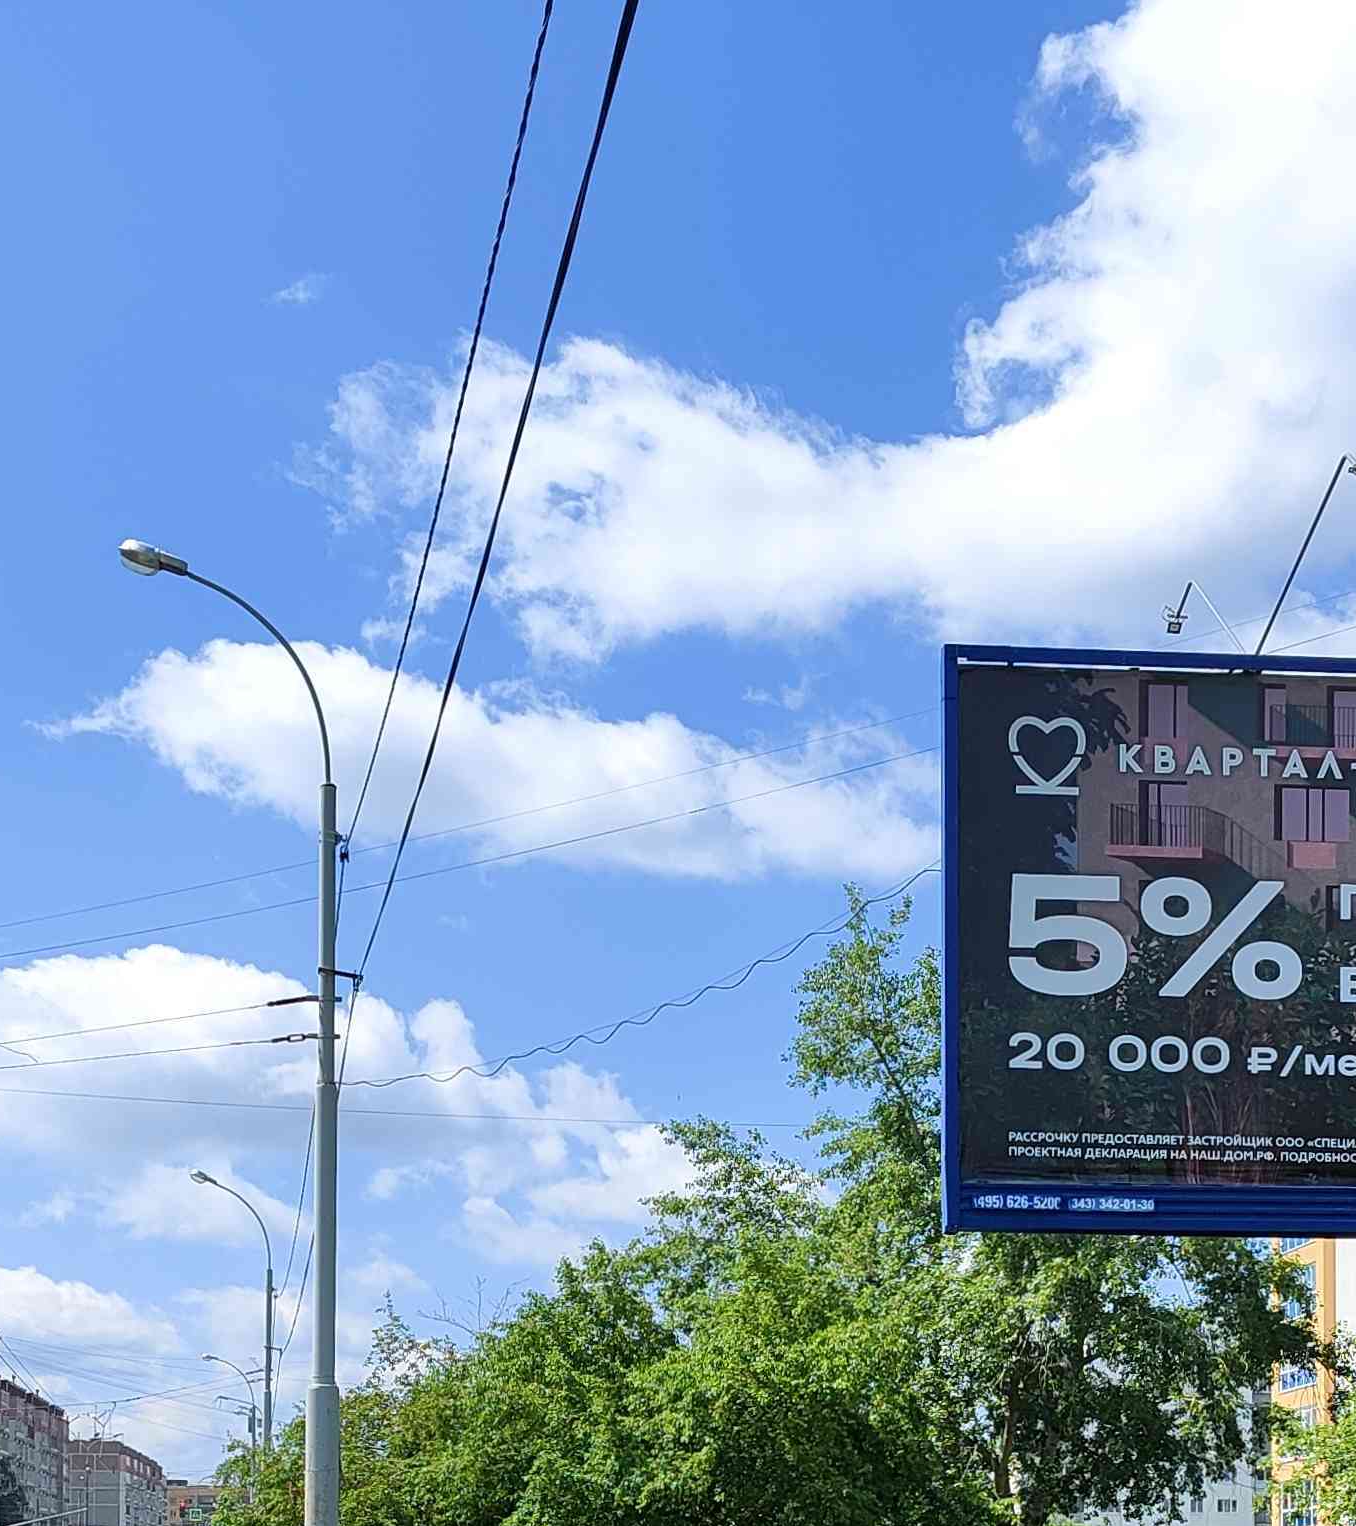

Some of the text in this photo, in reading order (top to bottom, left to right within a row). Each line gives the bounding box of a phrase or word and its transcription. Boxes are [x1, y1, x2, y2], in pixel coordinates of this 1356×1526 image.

[1007, 872, 1304, 1001] 5%
[1007, 1032, 1086, 1072] 20
[1107, 1034, 1231, 1074] 000
[1008, 1131, 1080, 1144] РАССРОЧКУ
[1081, 1133, 1185, 1146] ПРЕДОСТАВЛЯЕТ
[1187, 1134, 1274, 1149] ЗАСТРОЙЩИК
[1275, 1137, 1305, 1148] ООО
[1008, 1146, 1082, 1158] ПРОЕКТНАЯ
[1084, 1148, 1168, 1161] ДЕКЛАРАЦИЯ
[1170, 1150, 1188, 1160] НА
